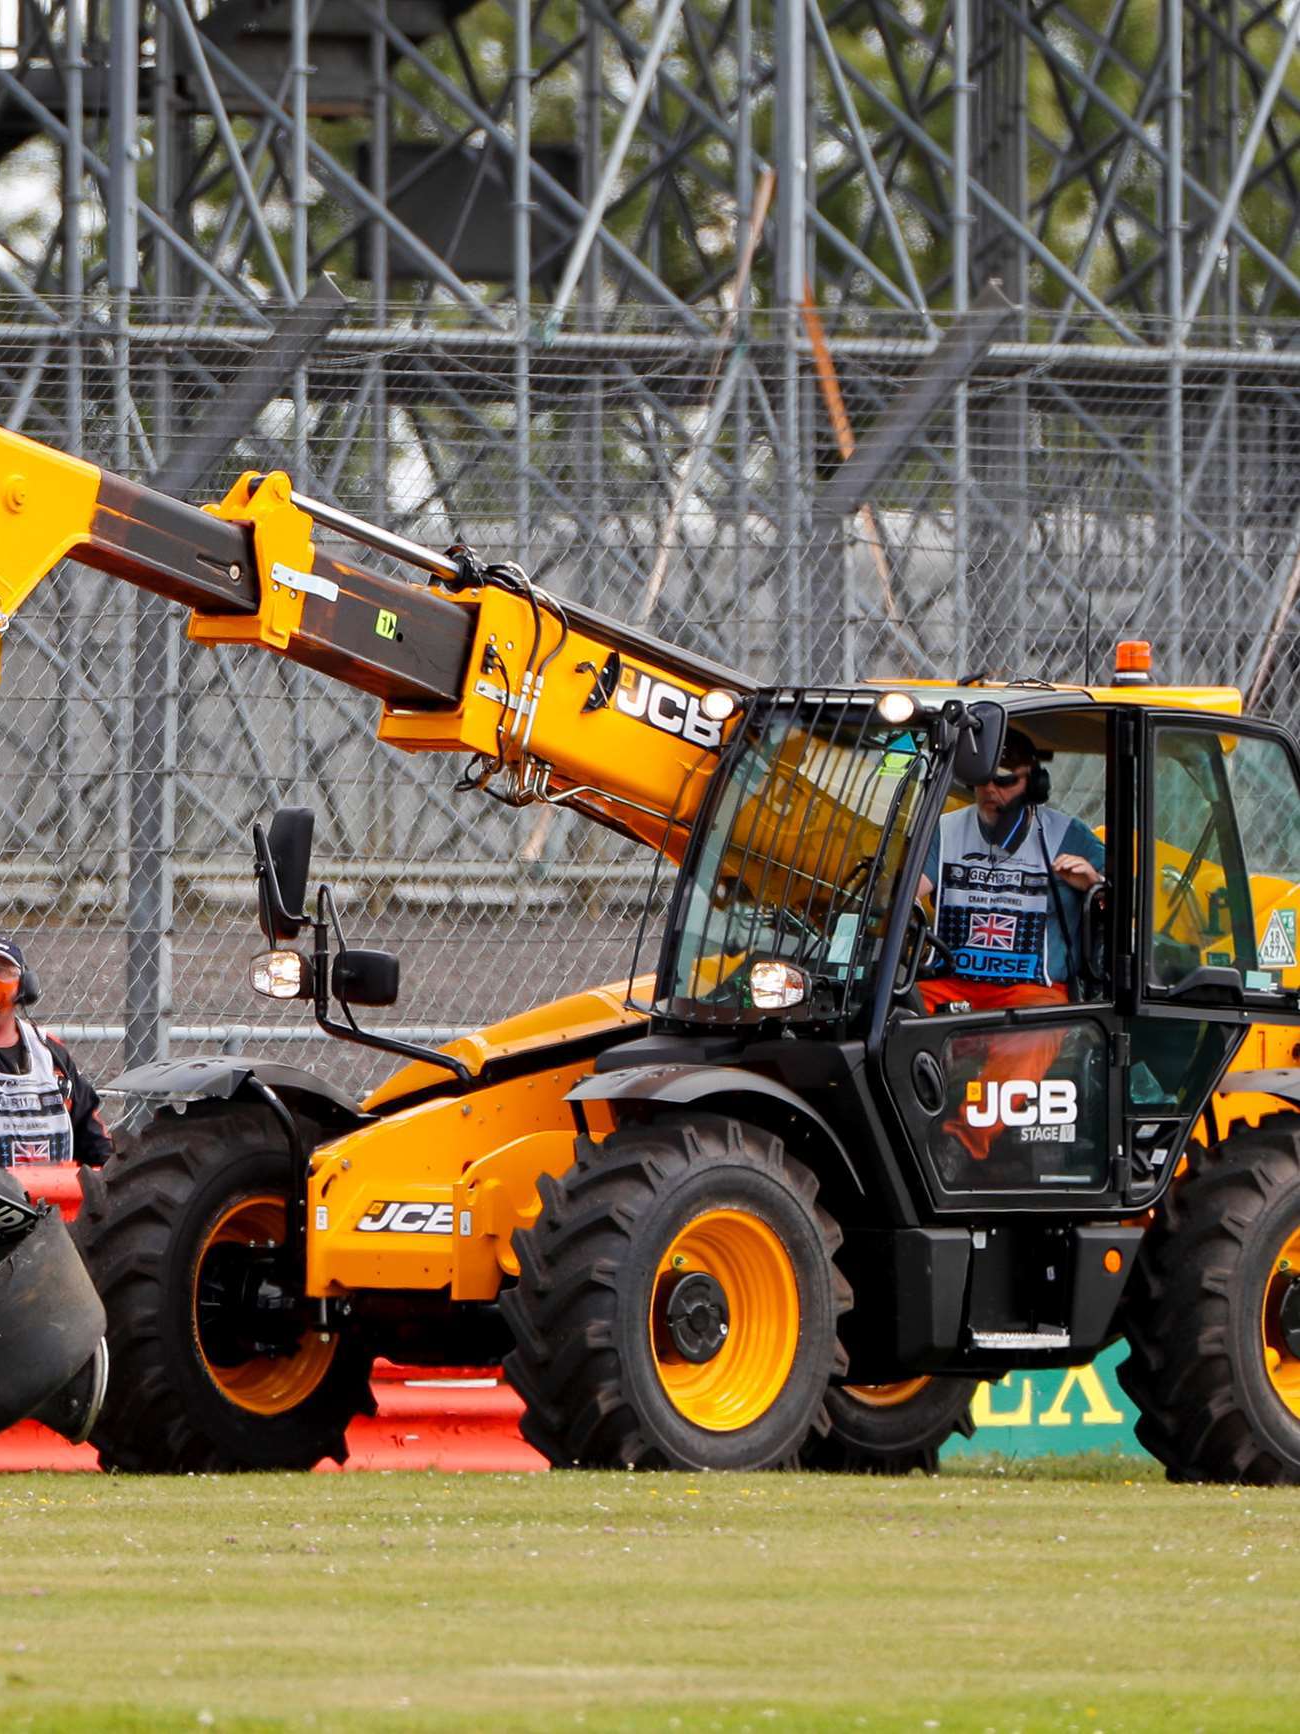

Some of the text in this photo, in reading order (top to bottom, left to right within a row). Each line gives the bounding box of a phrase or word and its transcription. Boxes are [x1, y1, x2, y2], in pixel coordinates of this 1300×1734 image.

[615, 673, 724, 748] JCB
[956, 952, 1030, 975] OURSE
[965, 1080, 1078, 1128] JCB
[1020, 1126, 1059, 1141] STAGE
[357, 1202, 454, 1232] JCB
